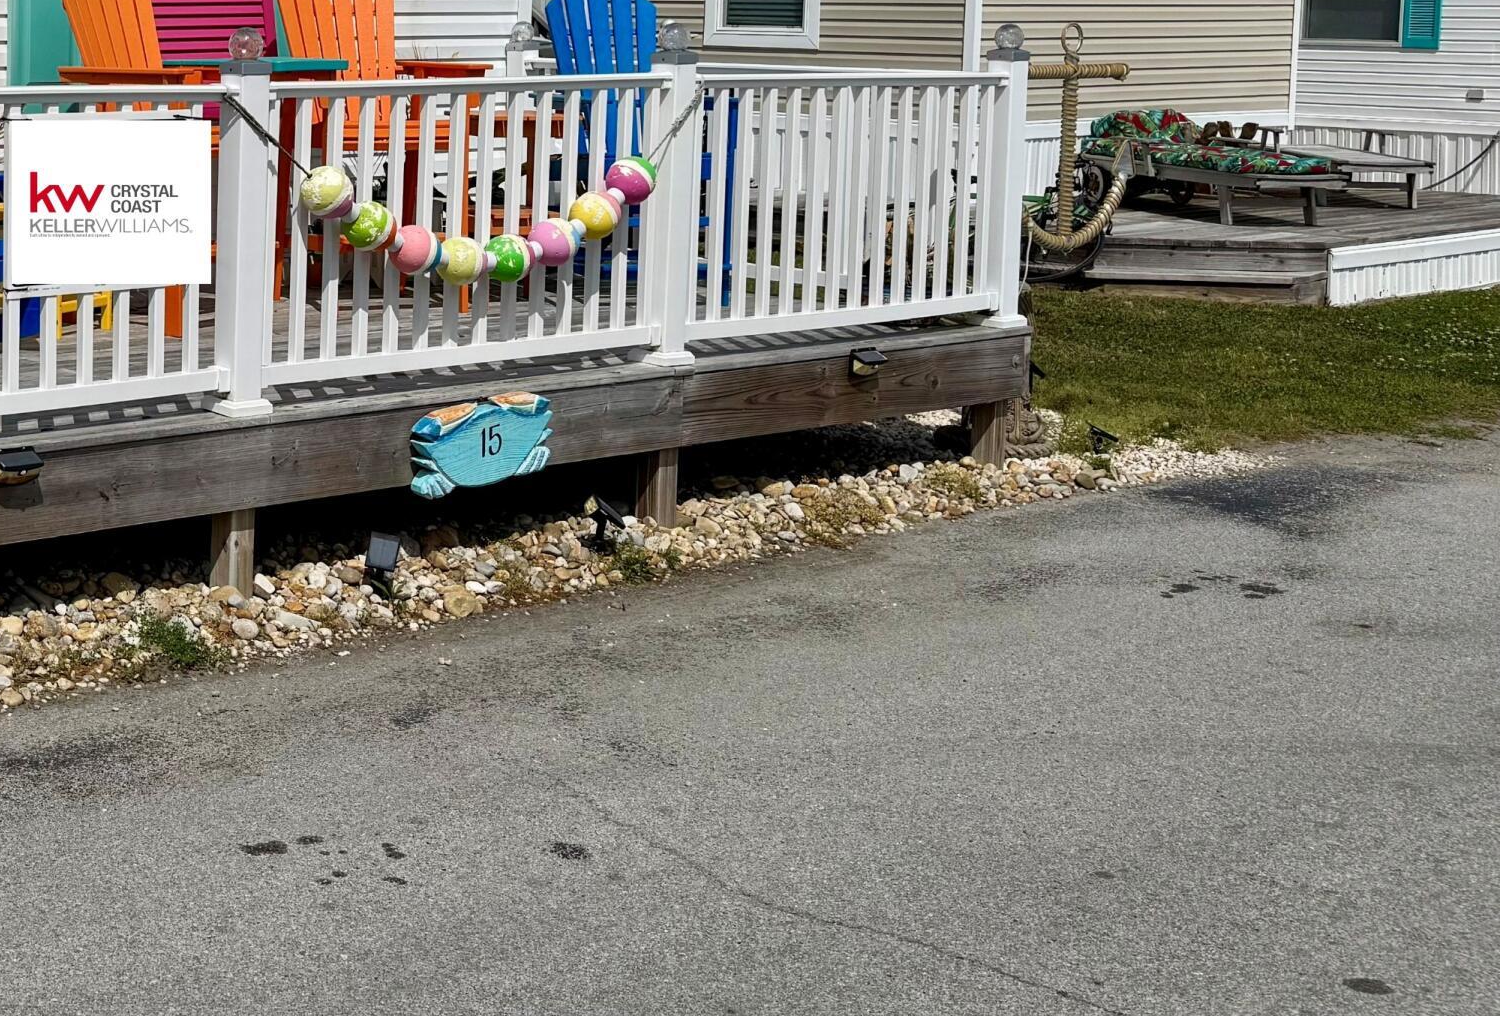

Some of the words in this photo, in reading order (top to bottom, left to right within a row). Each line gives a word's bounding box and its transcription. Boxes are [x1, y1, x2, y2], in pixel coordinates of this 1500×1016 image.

[111, 185, 178, 198] CRYSTAL
[111, 200, 161, 213] COAST
[481, 424, 503, 458] 15
